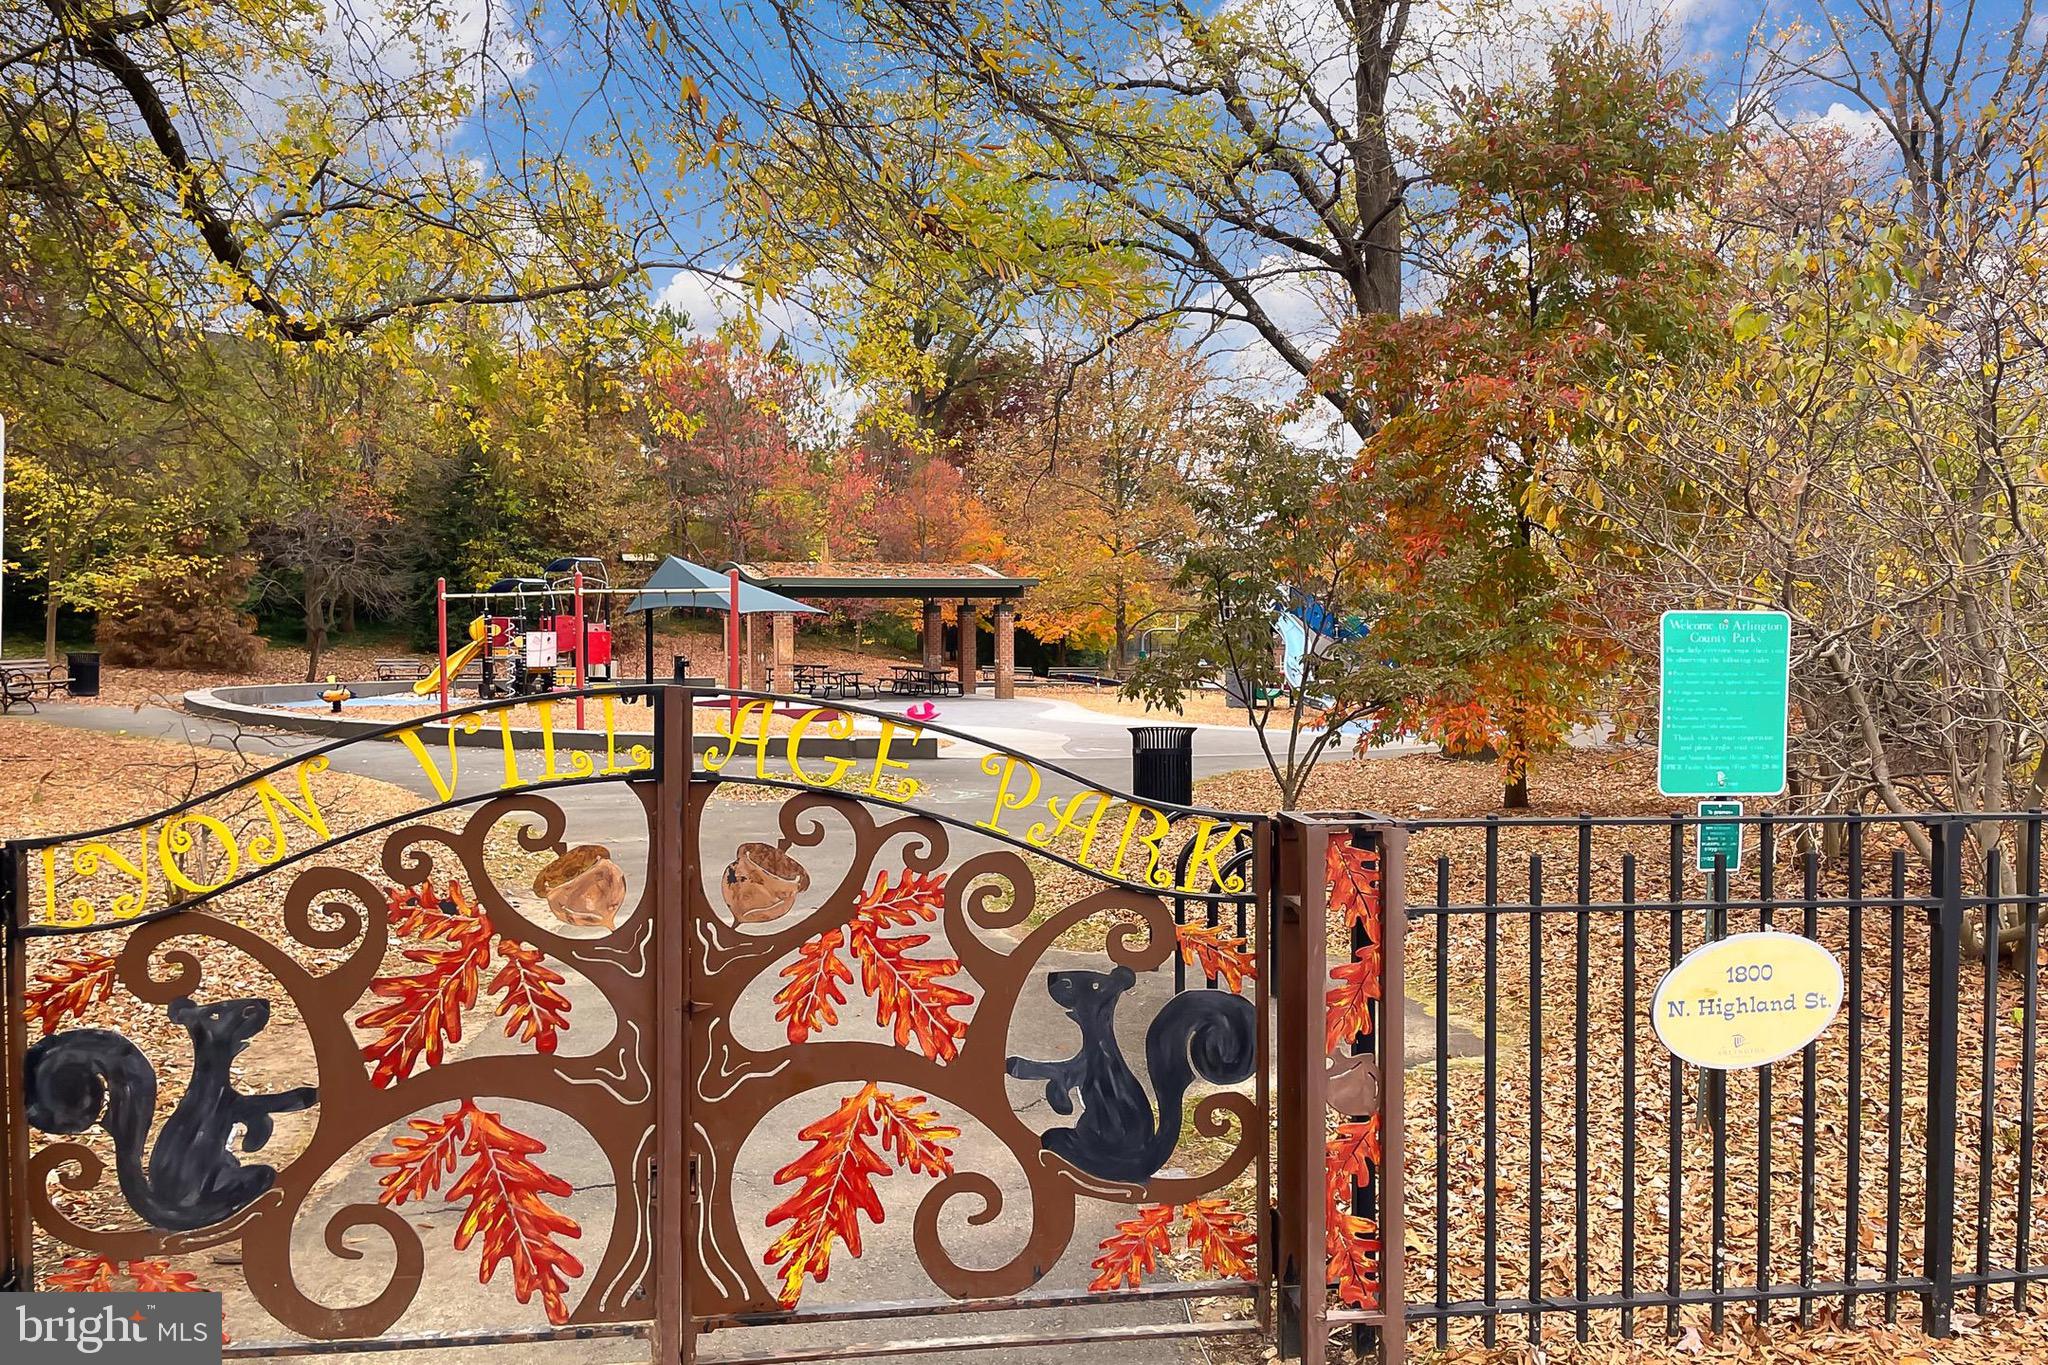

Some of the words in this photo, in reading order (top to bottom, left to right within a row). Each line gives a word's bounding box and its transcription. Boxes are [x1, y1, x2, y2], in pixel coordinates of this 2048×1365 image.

[1670, 619, 1713, 630] Welcome
[1719, 620, 1728, 630] to
[1732, 620, 1783, 633] Arlington
[1690, 632, 1726, 643] County
[1732, 632, 1761, 643] Parks
[41, 755, 332, 929] LYON
[976, 752, 1247, 894] PARK
[1726, 964, 1773, 983] 1800
[1667, 1000, 1690, 1018] N.
[1698, 994, 1797, 1021] Highland
[1804, 992, 1832, 1010] St.
